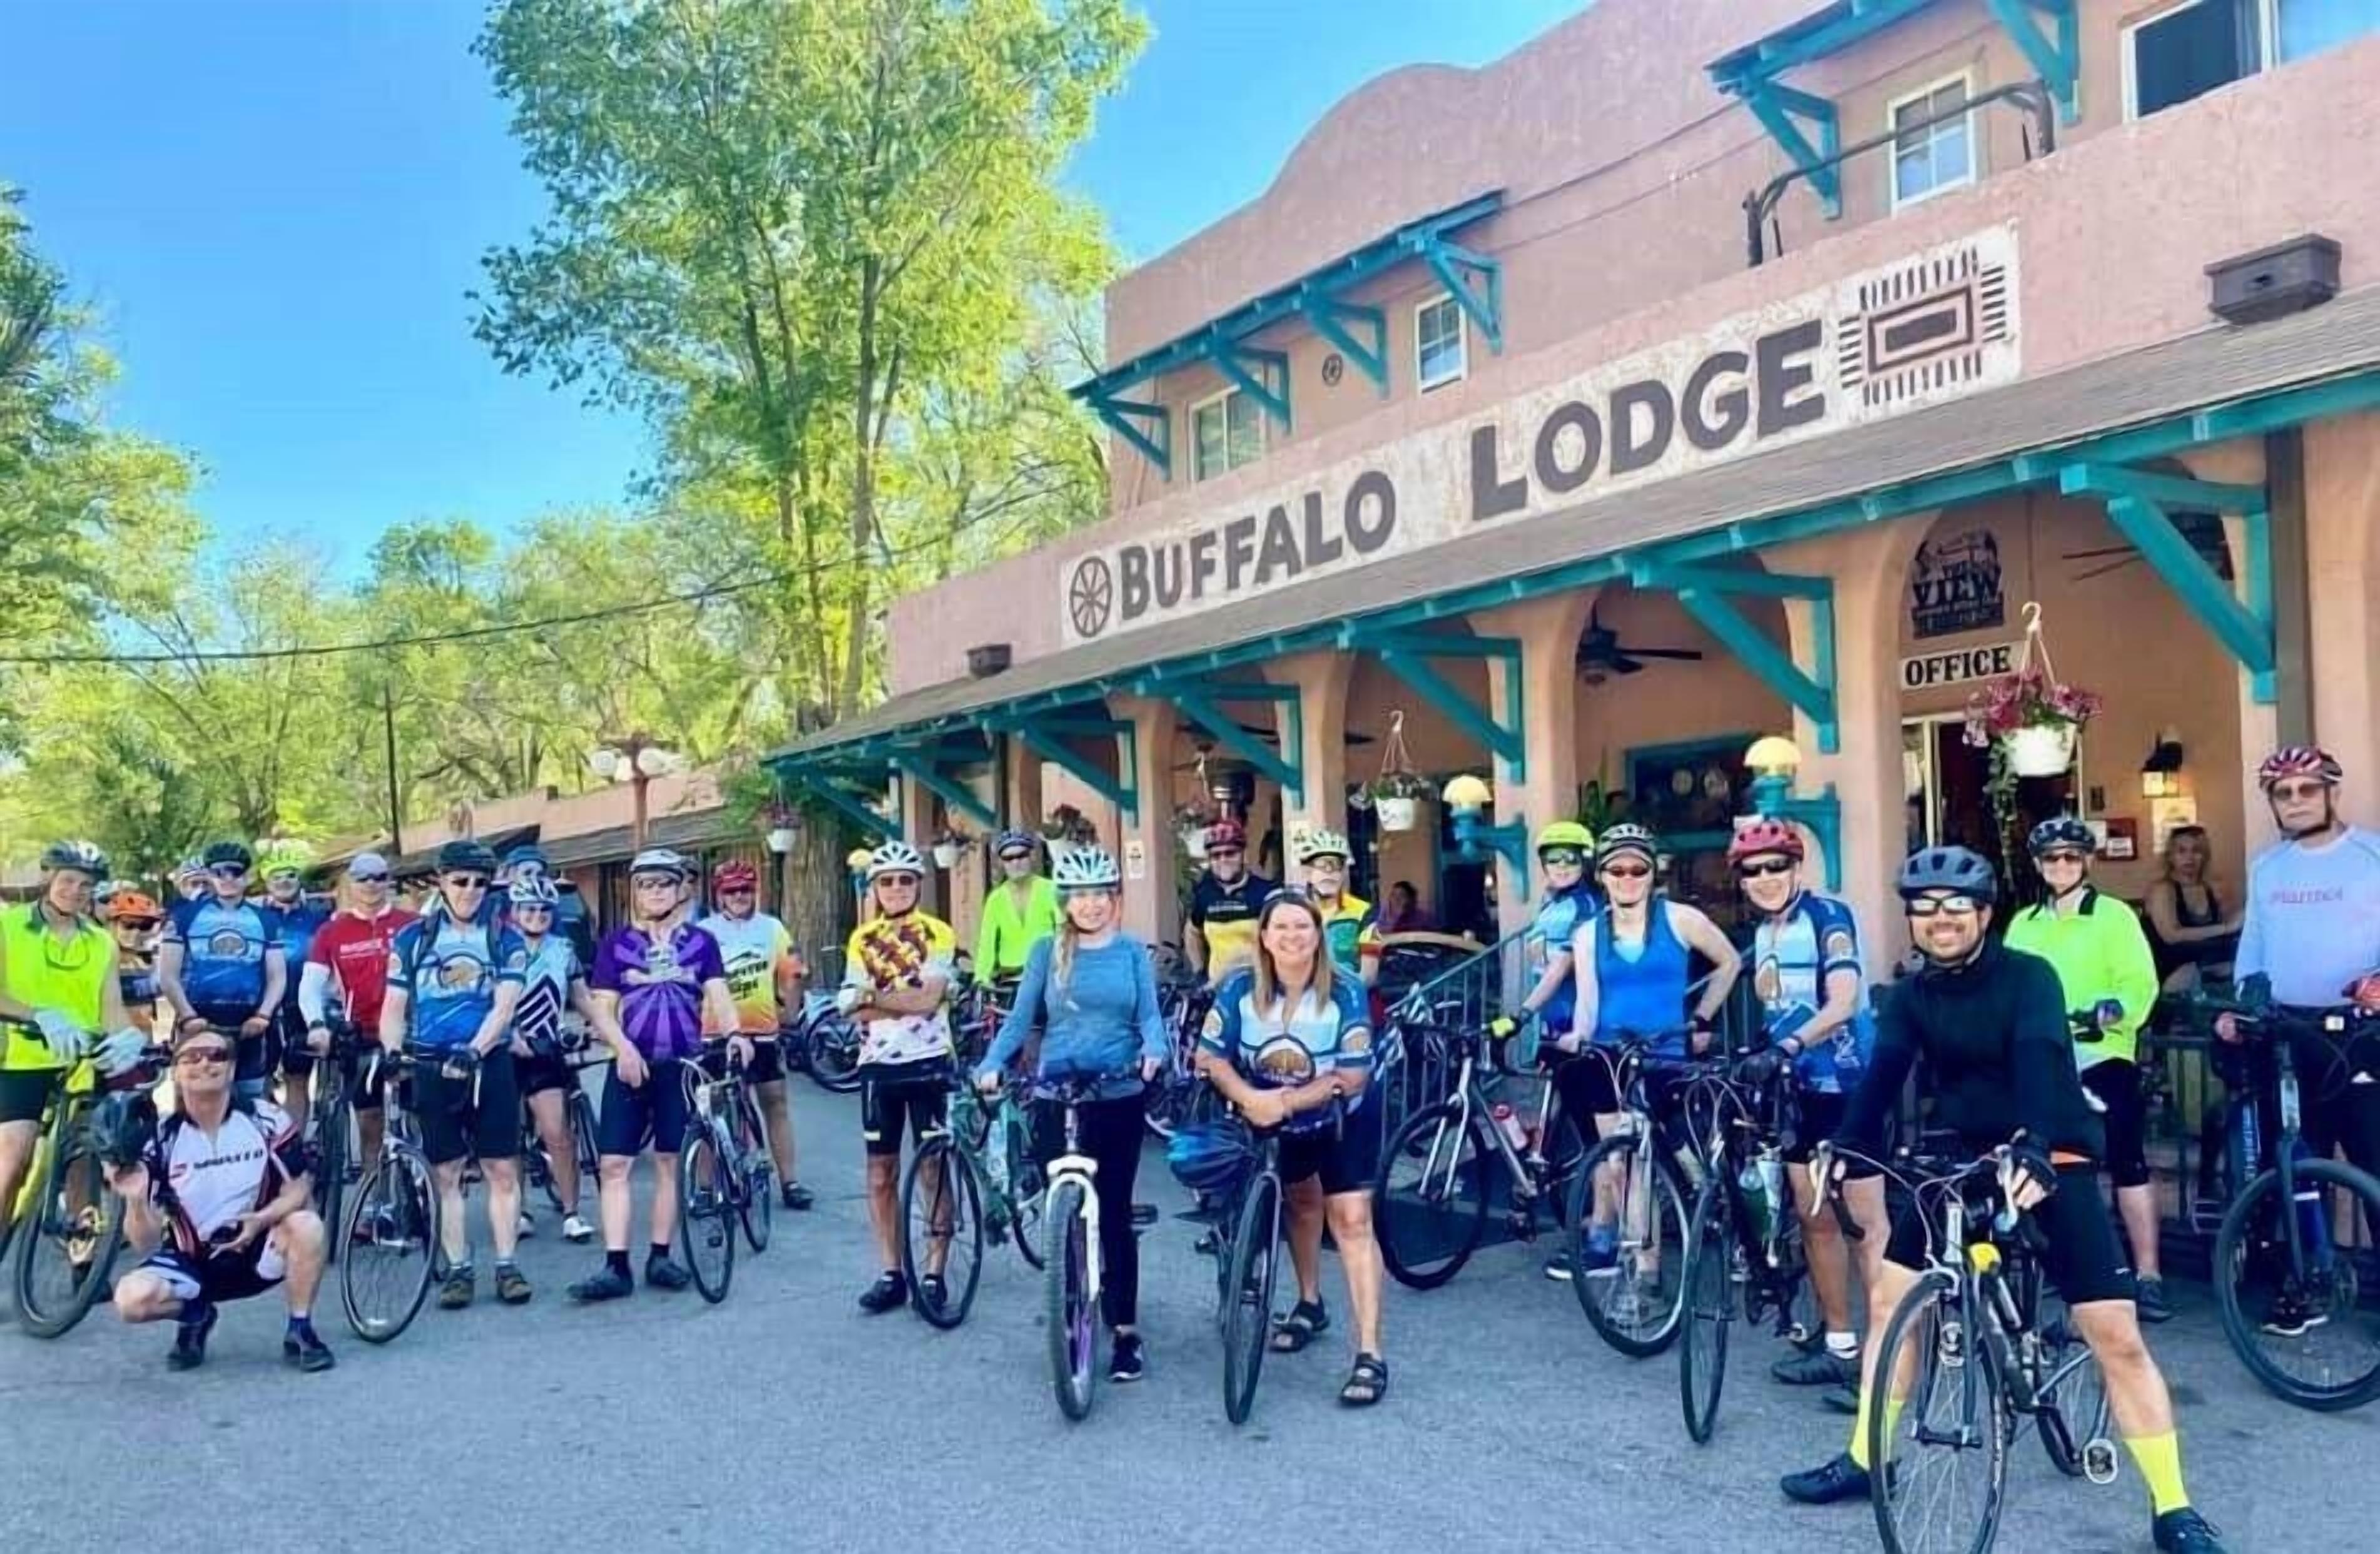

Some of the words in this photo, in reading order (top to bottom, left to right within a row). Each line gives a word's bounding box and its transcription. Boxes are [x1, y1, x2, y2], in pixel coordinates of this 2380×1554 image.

[1119, 470, 1396, 620] BUFFALO
[1472, 319, 1825, 521] LODGE
[1913, 568, 2001, 609] VIEW
[1905, 645, 2011, 686] OFFICE
